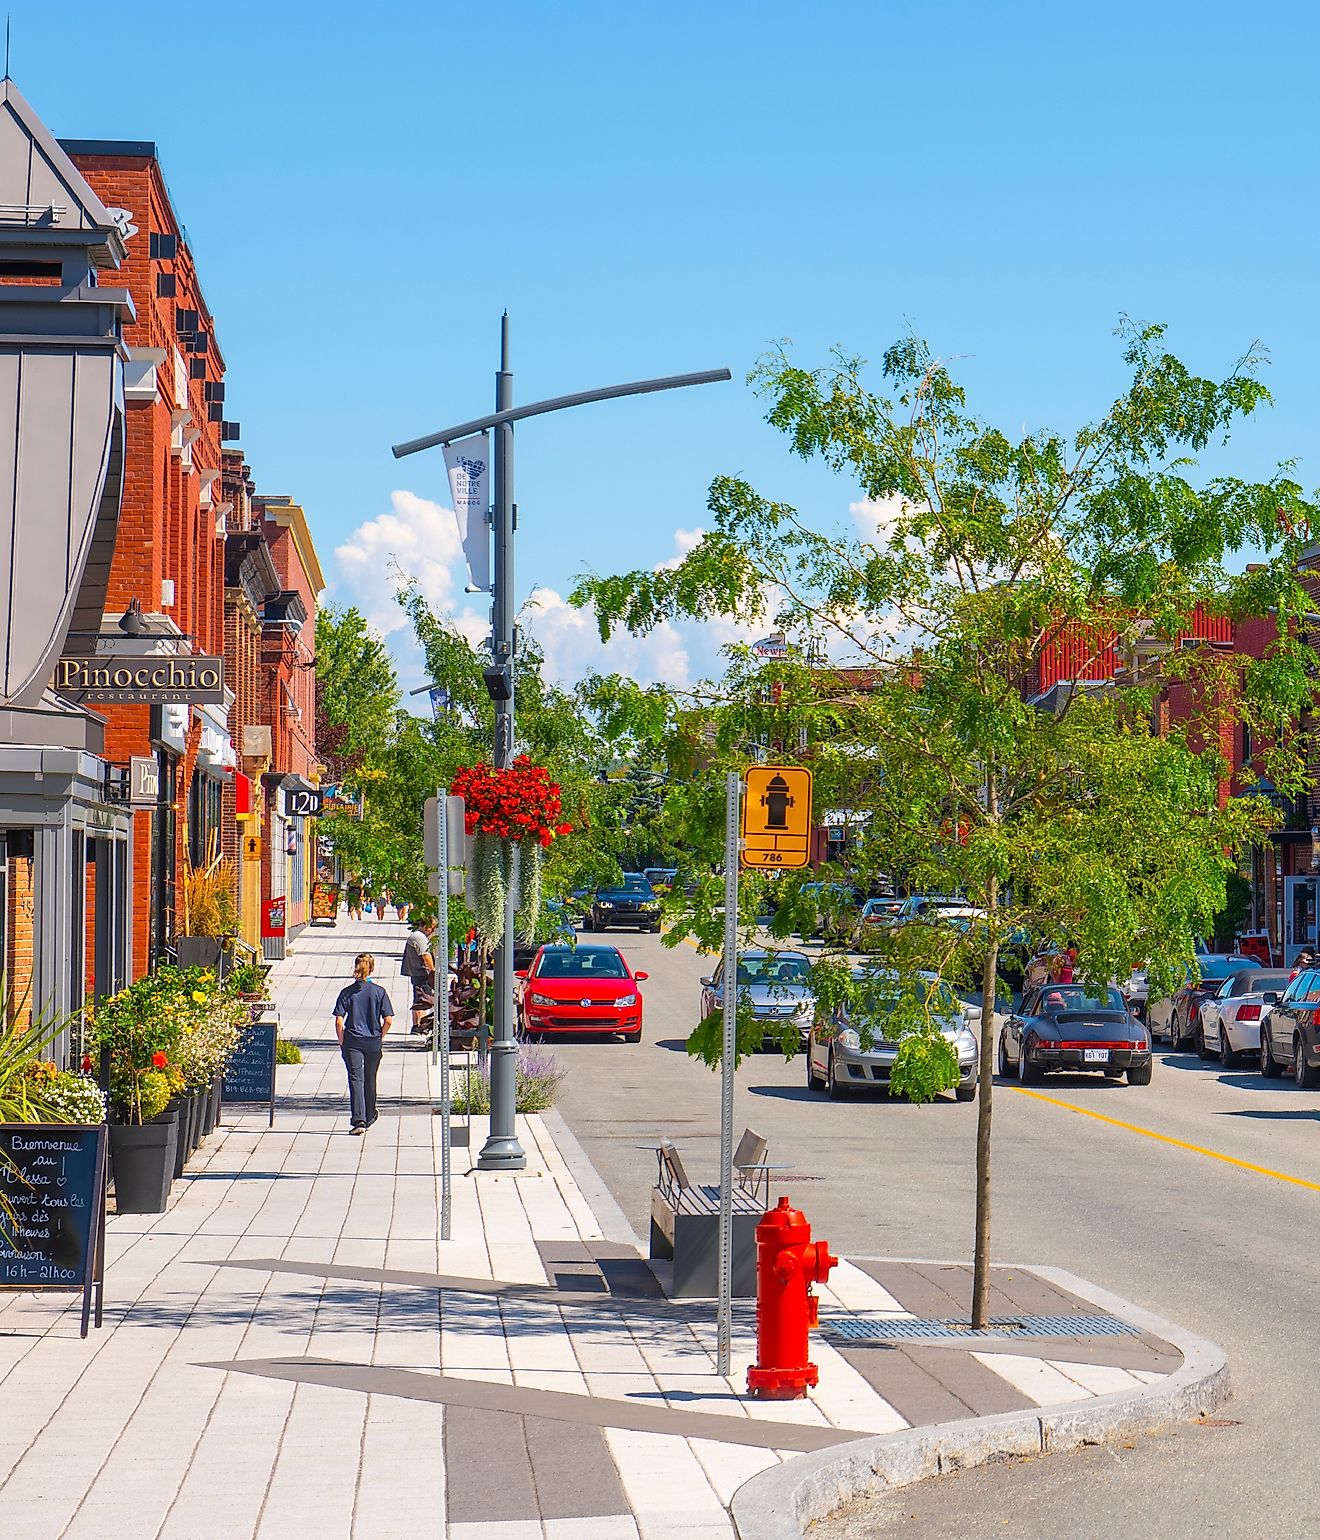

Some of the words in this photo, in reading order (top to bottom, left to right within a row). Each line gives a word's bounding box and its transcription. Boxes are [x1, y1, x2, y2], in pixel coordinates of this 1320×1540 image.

[456, 480, 481, 488] NOTRE
[456, 487, 478, 495] VILLE
[60, 660, 218, 688] Pinocchio
[86, 692, 192, 700] restaurant
[763, 853, 783, 862] 786
[11, 1135, 84, 1152] Bienvenue
[32, 1155, 58, 1166] au
[41, 1193, 69, 1208] tous
[70, 1193, 85, 1208] les
[31, 1209, 50, 1223] dès
